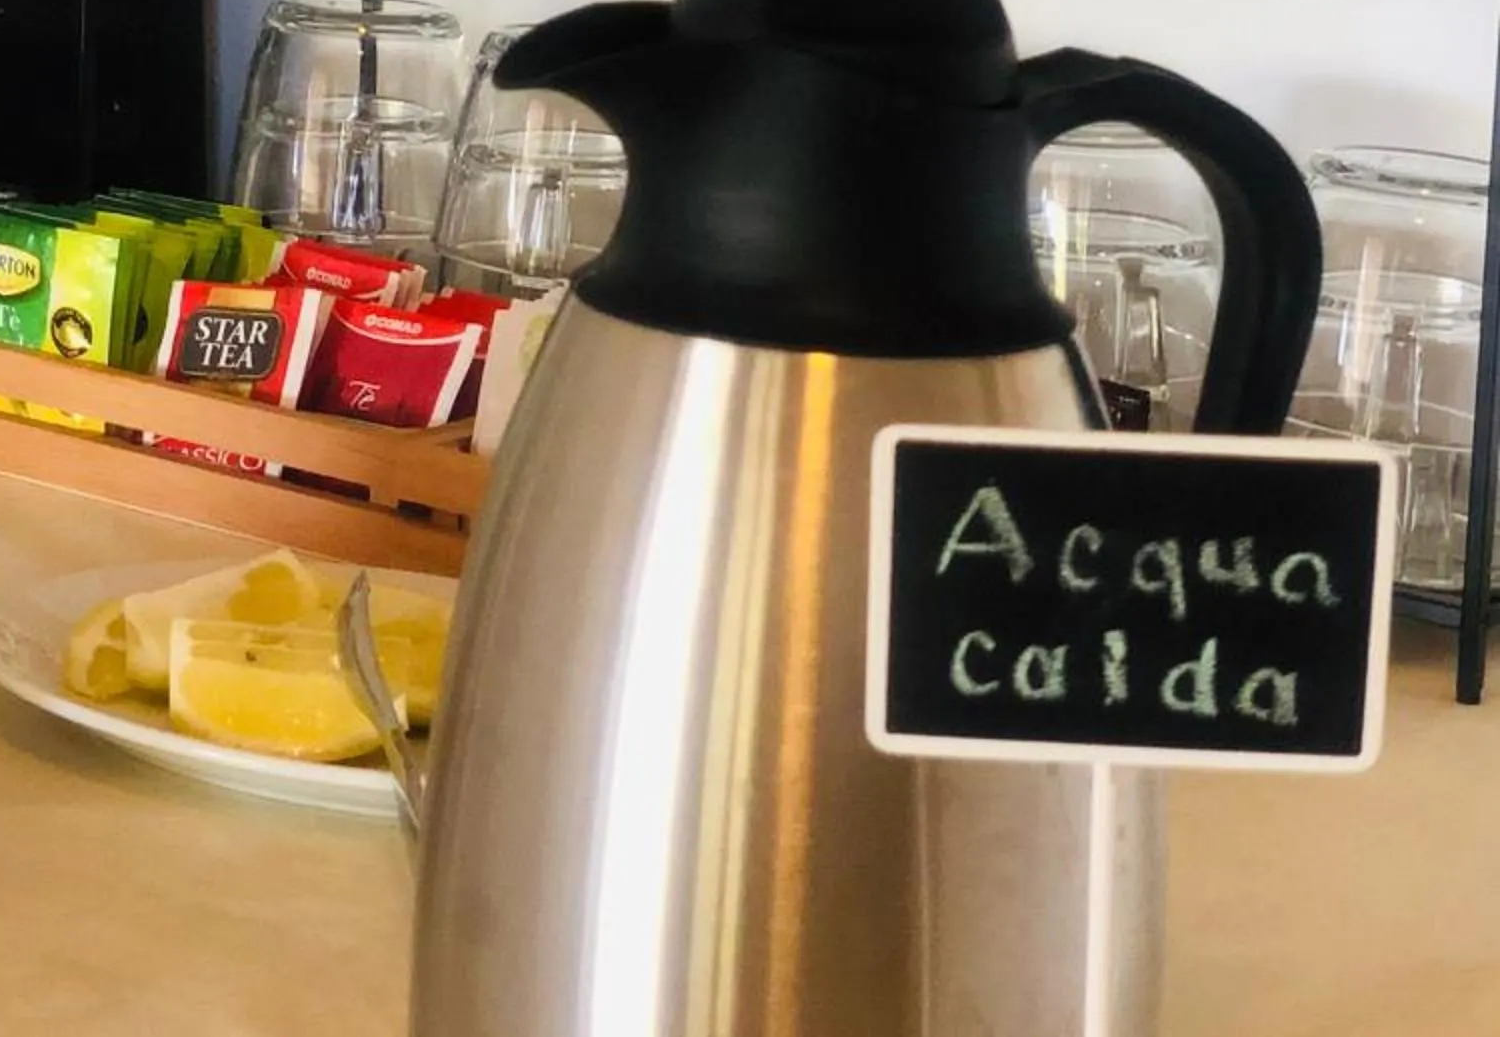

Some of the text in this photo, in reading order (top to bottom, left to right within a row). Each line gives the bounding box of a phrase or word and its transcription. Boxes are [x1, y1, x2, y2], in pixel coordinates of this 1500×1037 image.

[195, 316, 269, 345] STAR
[199, 342, 253, 369] TEA
[935, 482, 1341, 621] Acqua
[949, 628, 1299, 727] calda
